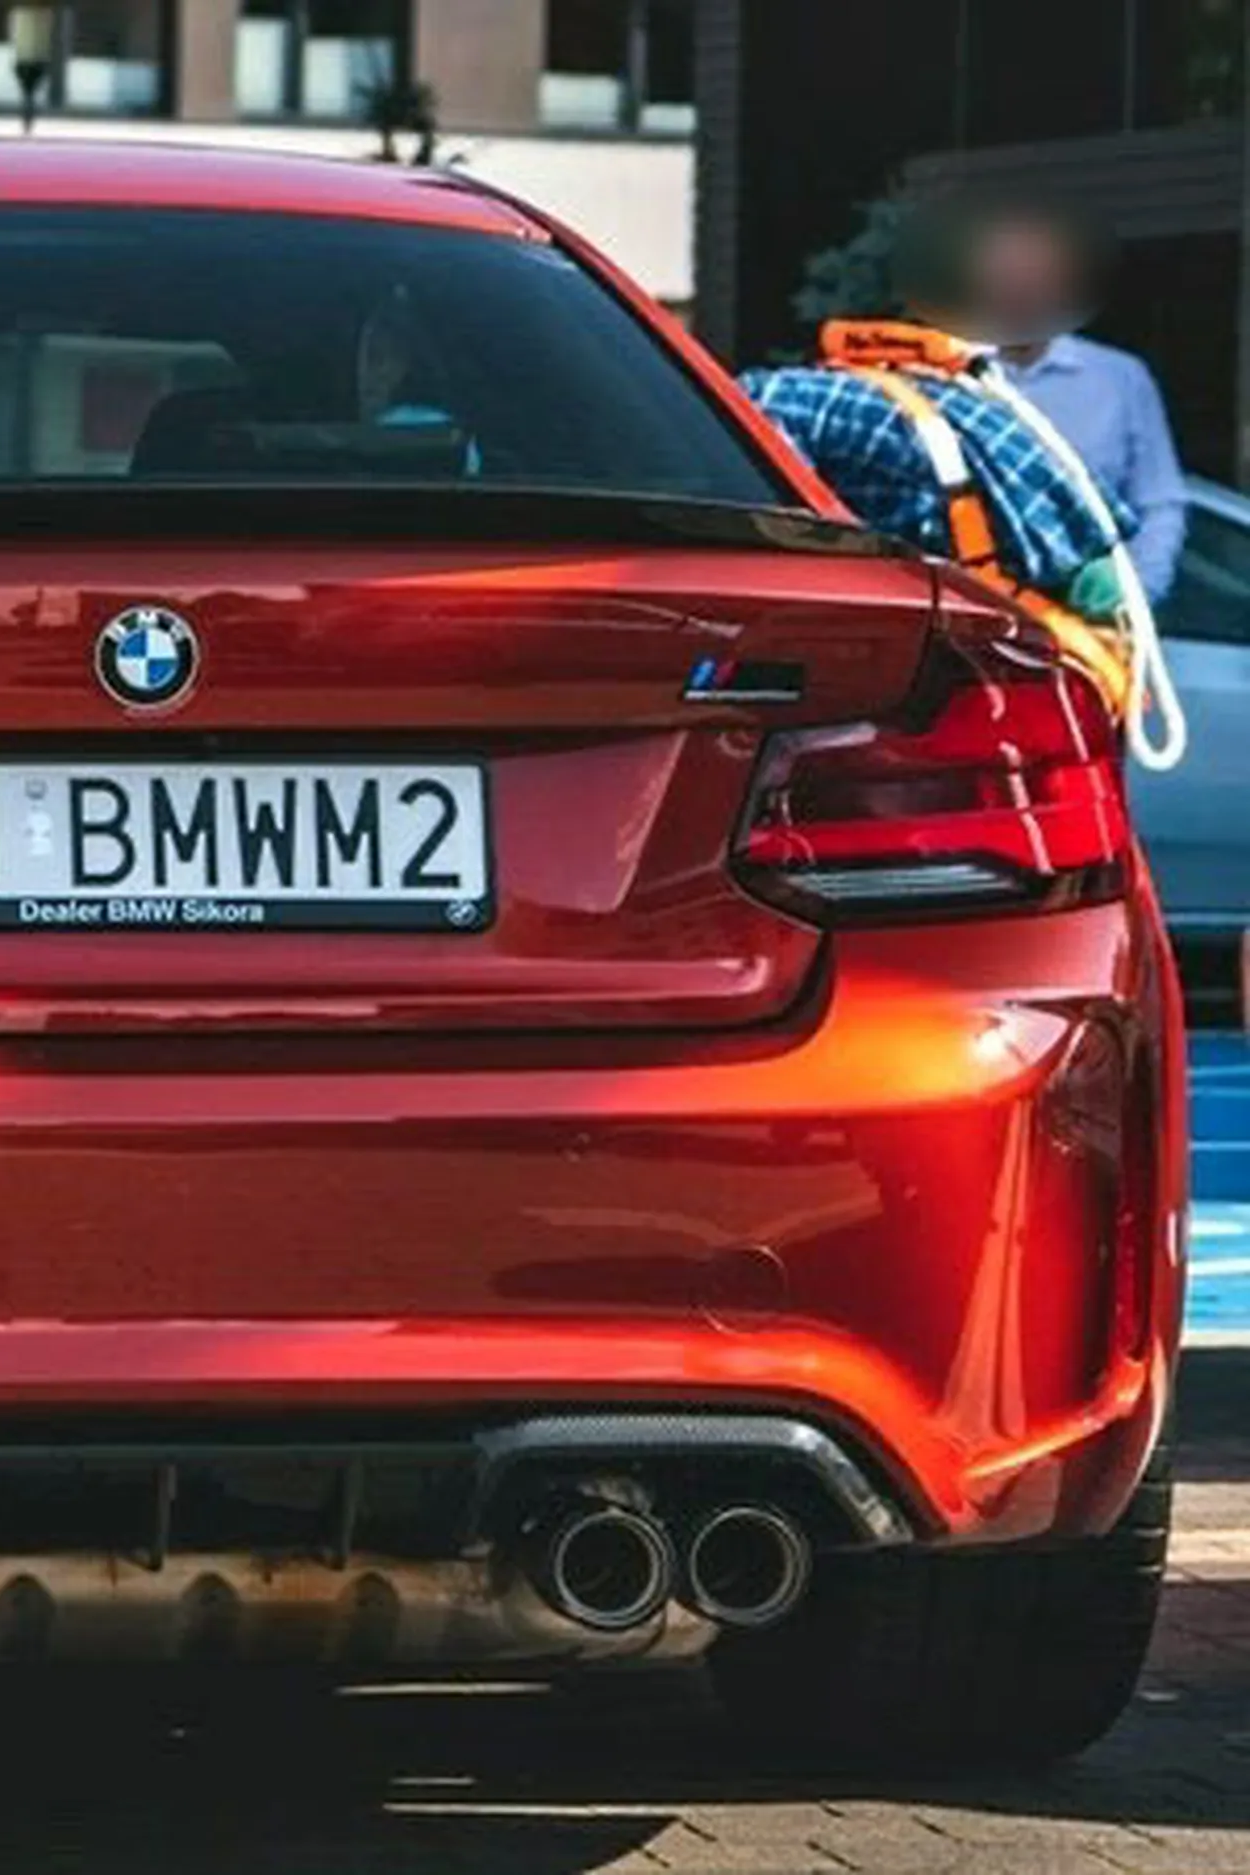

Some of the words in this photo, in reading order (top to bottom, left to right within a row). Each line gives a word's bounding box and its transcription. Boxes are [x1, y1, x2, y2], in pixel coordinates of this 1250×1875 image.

[69, 777, 463, 888] BMWM2
[19, 899, 103, 922] Dealer
[107, 899, 177, 922] BMW
[182, 899, 265, 922] Sikora
